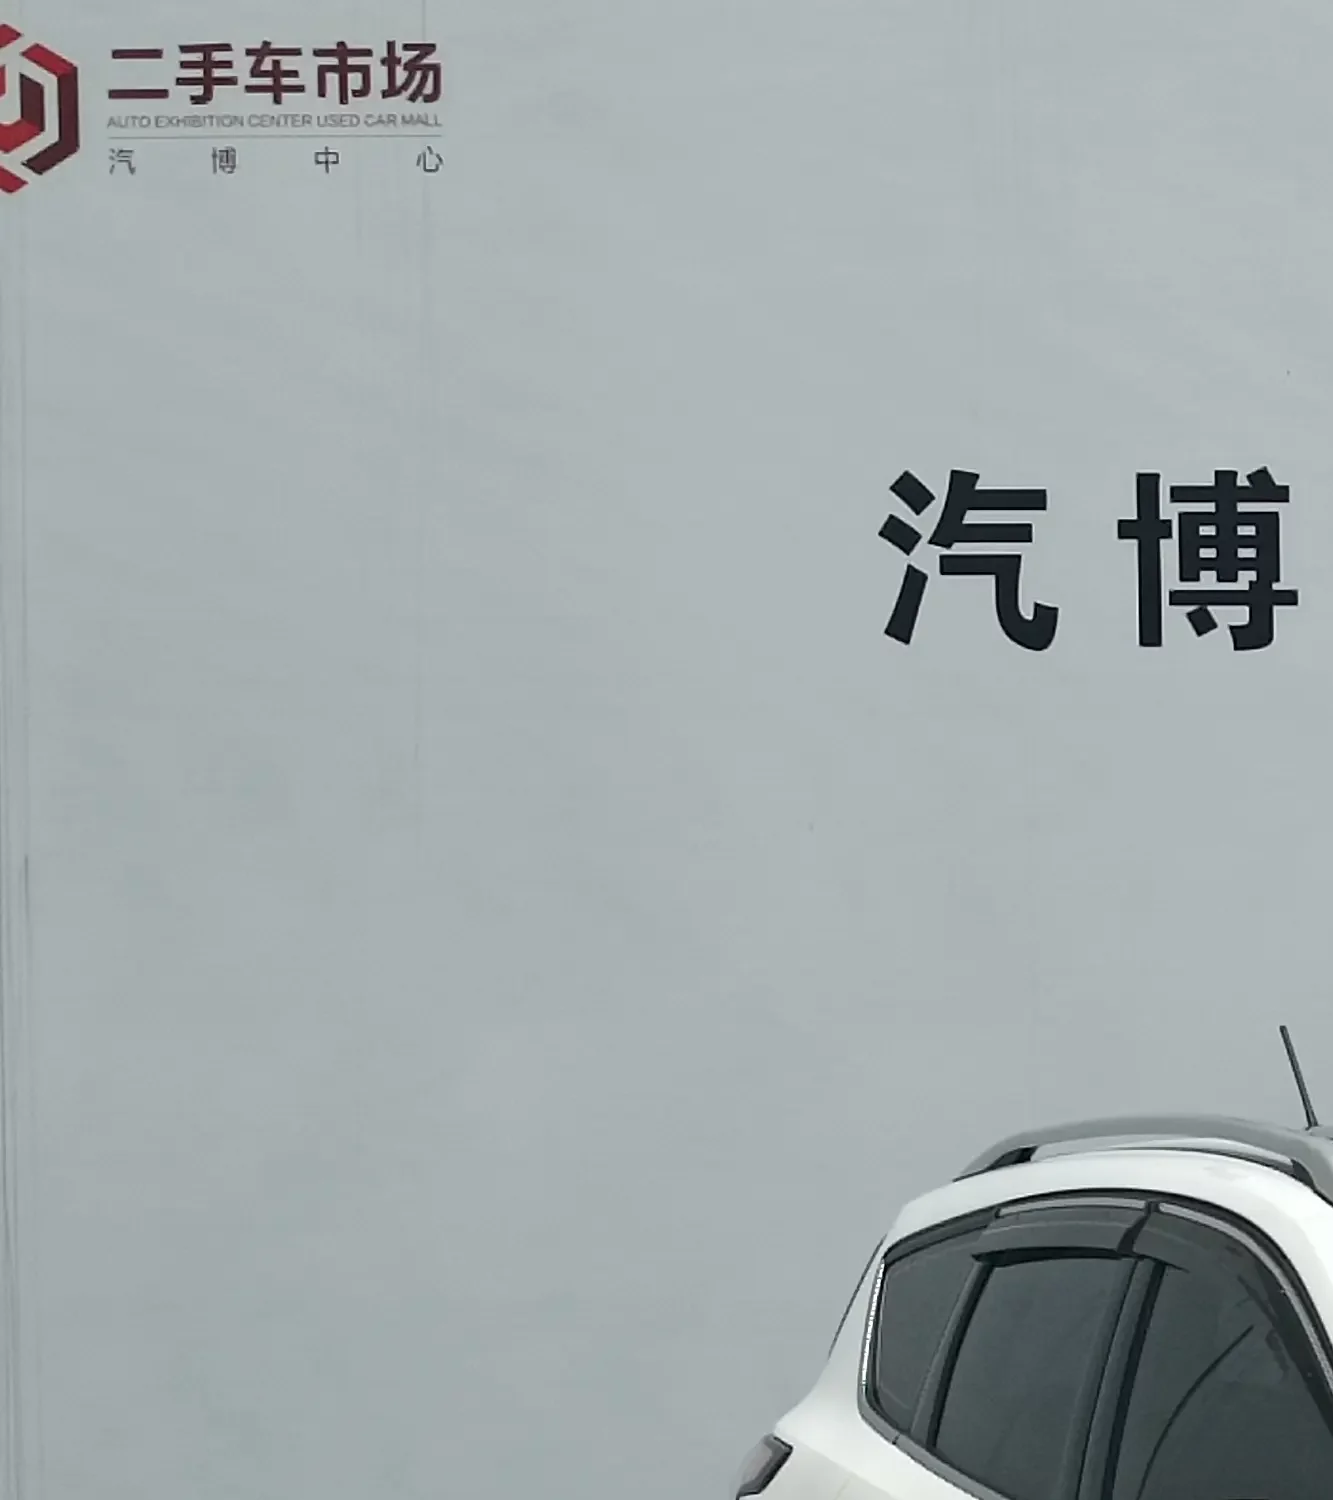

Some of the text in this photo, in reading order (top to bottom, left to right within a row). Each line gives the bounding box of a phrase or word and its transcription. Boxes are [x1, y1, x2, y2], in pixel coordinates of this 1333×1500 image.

[107, 40, 442, 105] 二手车市场
[107, 112, 443, 129] AUTO EXHIBITION CENTER USED CAR MALL
[108, 146, 443, 175] 汽博中心
